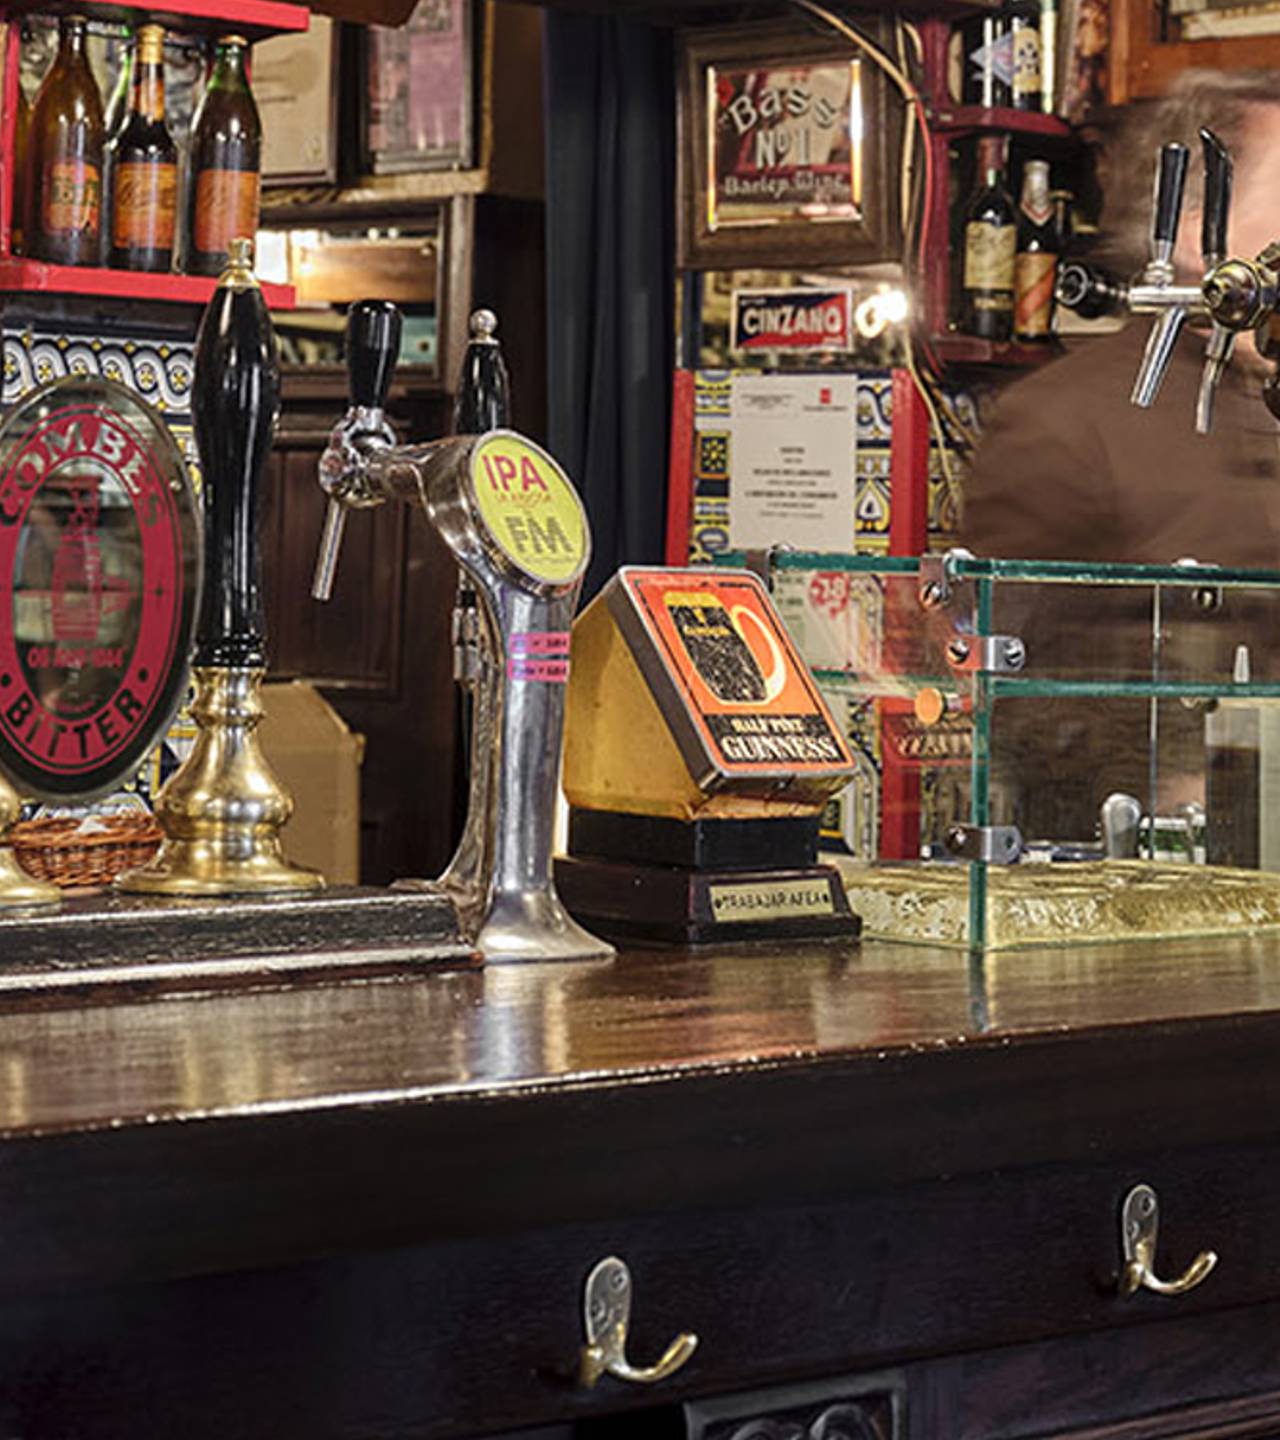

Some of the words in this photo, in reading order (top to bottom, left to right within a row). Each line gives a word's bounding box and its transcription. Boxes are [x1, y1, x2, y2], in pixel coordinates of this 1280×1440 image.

[741, 306, 844, 337] CINZANO
[482, 454, 549, 493] IPA
[505, 515, 575, 555] FM
[4, 690, 145, 760] BITTER
[721, 734, 840, 760] GUINNESS
